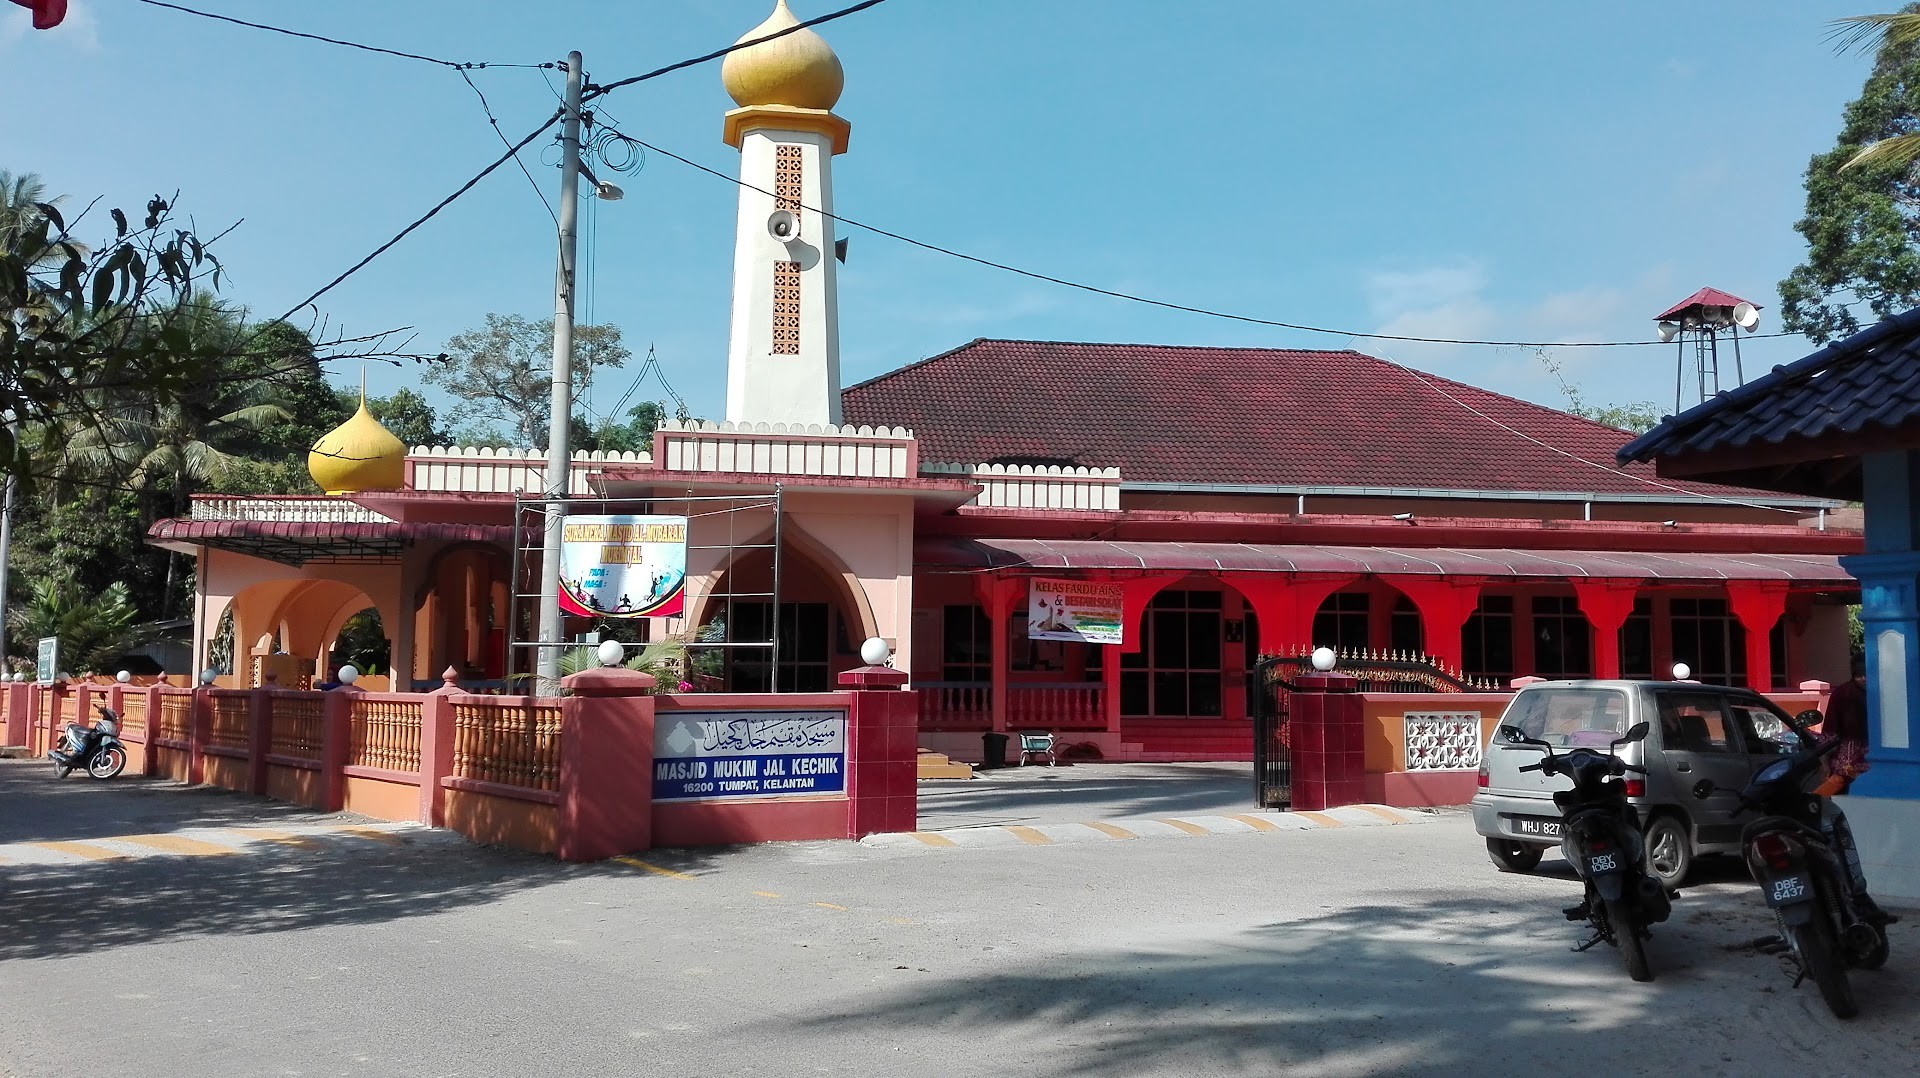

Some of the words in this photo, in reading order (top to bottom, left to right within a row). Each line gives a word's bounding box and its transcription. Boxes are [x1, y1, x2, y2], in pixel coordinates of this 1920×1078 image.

[563, 523, 605, 543] SUKANEKA
[605, 524, 634, 546] MASJID
[633, 524, 685, 543] AL-MUBARAK
[627, 545, 643, 568] JAL
[1035, 582, 1064, 593] KELAS
[1065, 583, 1097, 595] FARDU
[1054, 594, 1063, 606] &
[657, 761, 707, 781] MASJID
[713, 759, 757, 779] MUKIM
[763, 758, 786, 777] JAL
[791, 756, 839, 775] KECHIK
[682, 782, 714, 793] 16200
[718, 780, 759, 792] TUMPAT,
[763, 777, 815, 790] KELANTAN
[1521, 820, 1540, 833] WHJ
[1591, 854, 1612, 866] DBY
[1591, 861, 1617, 873] 1060
[1775, 877, 1798, 892] DBF
[1773, 885, 1805, 901] 6437
